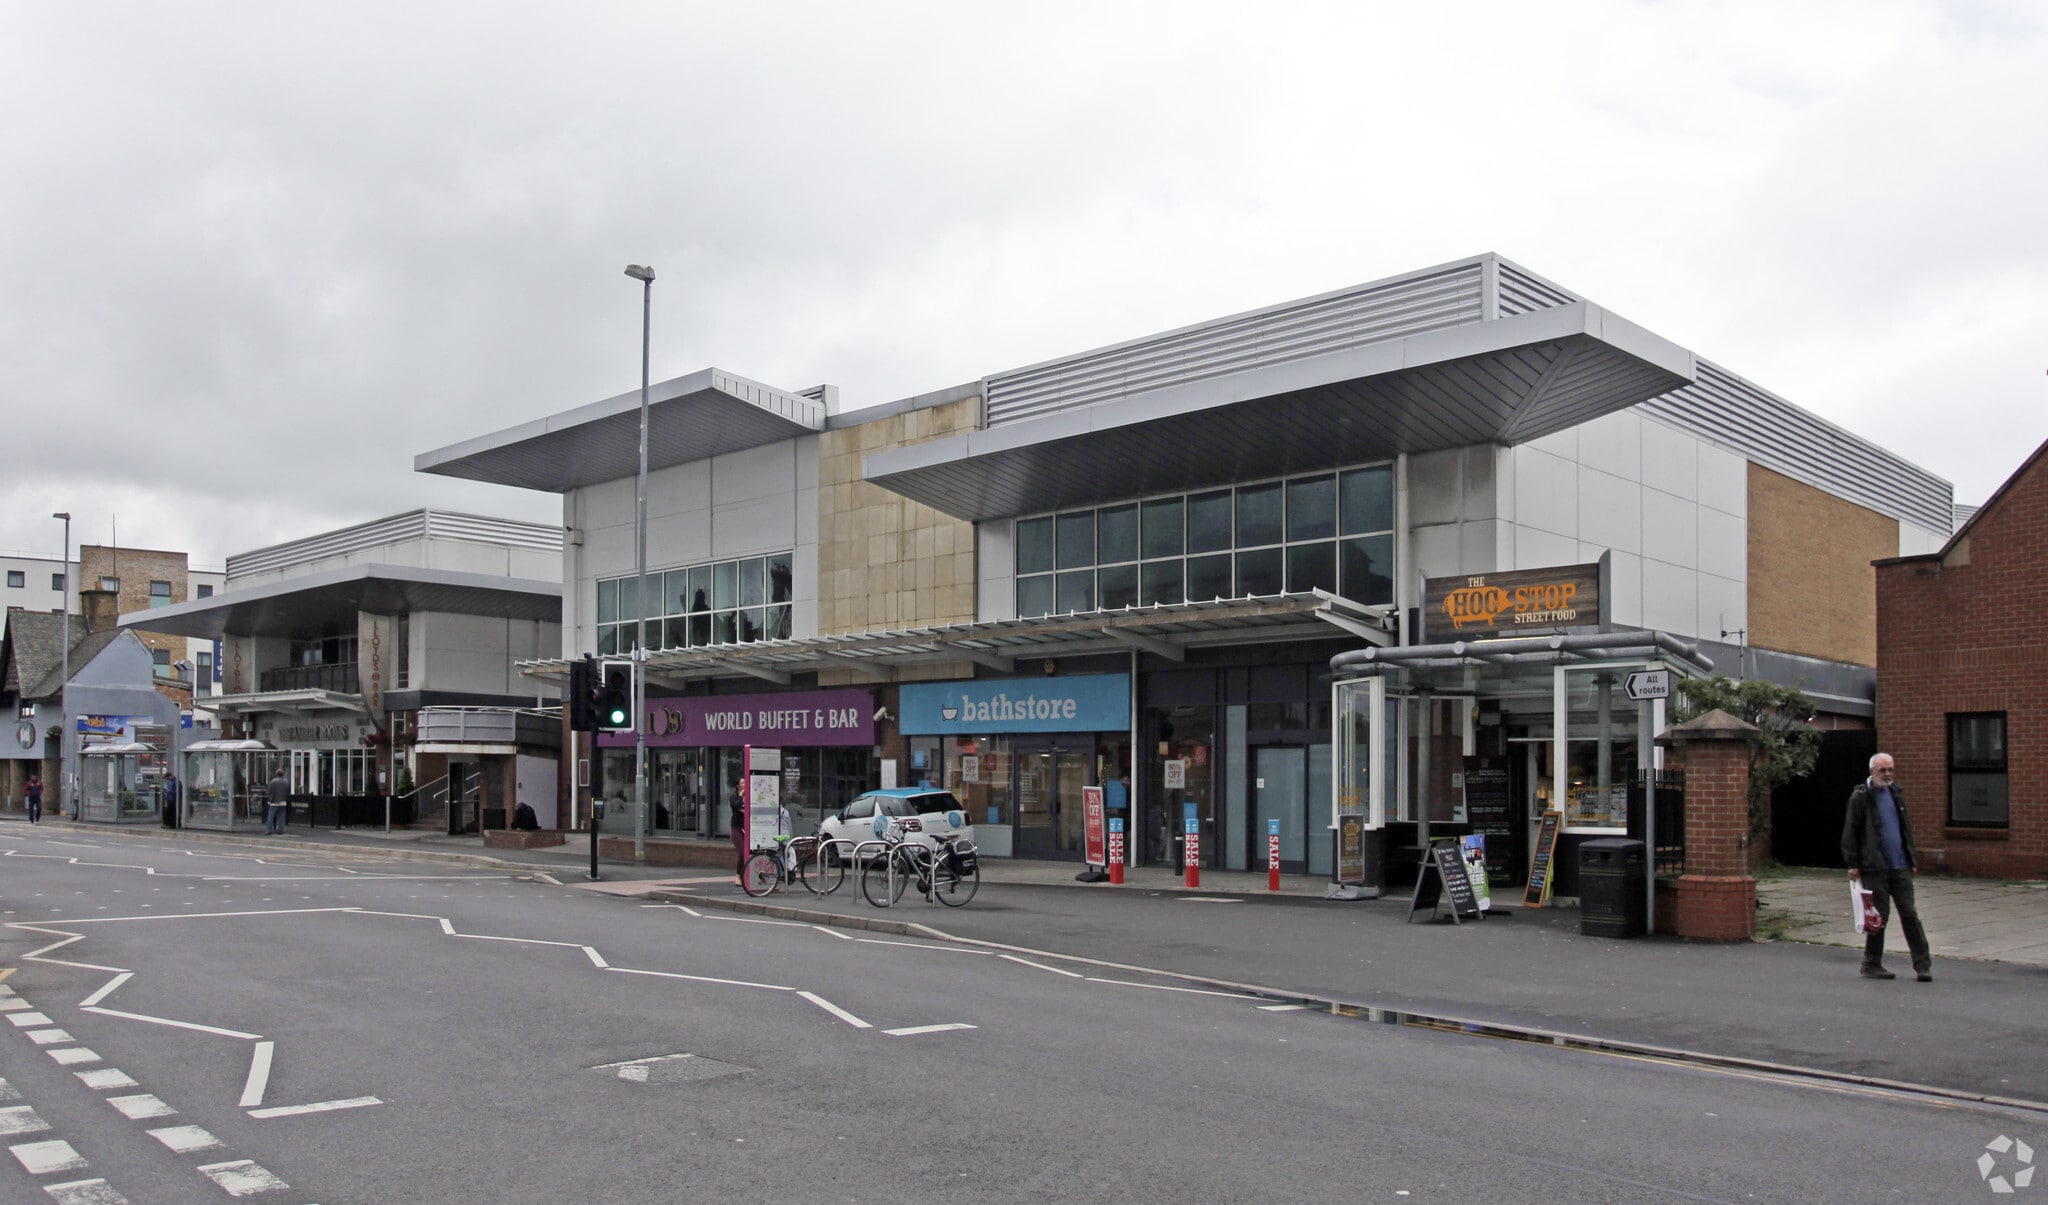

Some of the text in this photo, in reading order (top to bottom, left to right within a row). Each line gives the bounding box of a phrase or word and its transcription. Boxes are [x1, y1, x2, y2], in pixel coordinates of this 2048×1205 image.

[1467, 577, 1485, 587] THE
[1453, 583, 1577, 616] HOG STOP
[1514, 610, 1576, 624] STREET FOOD
[1639, 685, 1666, 694] routes
[1646, 675, 1658, 684] All
[962, 693, 1077, 721] bathstore
[705, 711, 752, 731] WORLD
[759, 710, 810, 730] BUFFET
[814, 709, 824, 729] &
[829, 708, 858, 728] BAR
[1191, 834, 1199, 866] SALE
[1269, 836, 1279, 869] SALE
